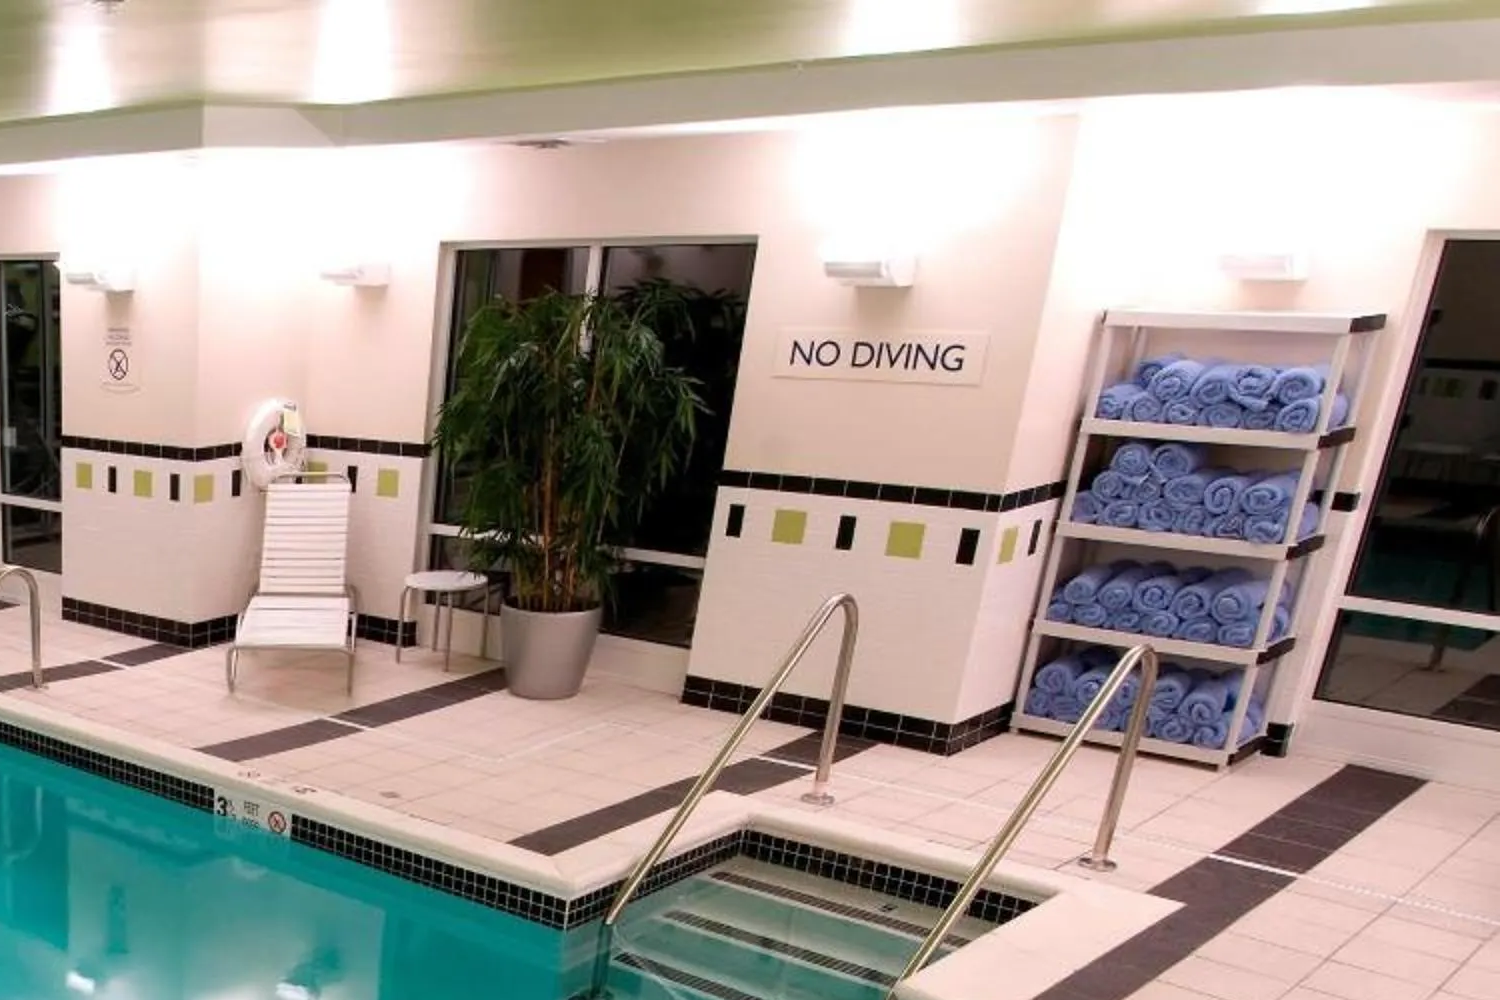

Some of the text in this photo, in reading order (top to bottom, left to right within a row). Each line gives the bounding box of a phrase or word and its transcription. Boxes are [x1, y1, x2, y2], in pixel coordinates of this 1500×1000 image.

[789, 340, 966, 372] NO DIVING
[217, 796, 228, 817] 3
